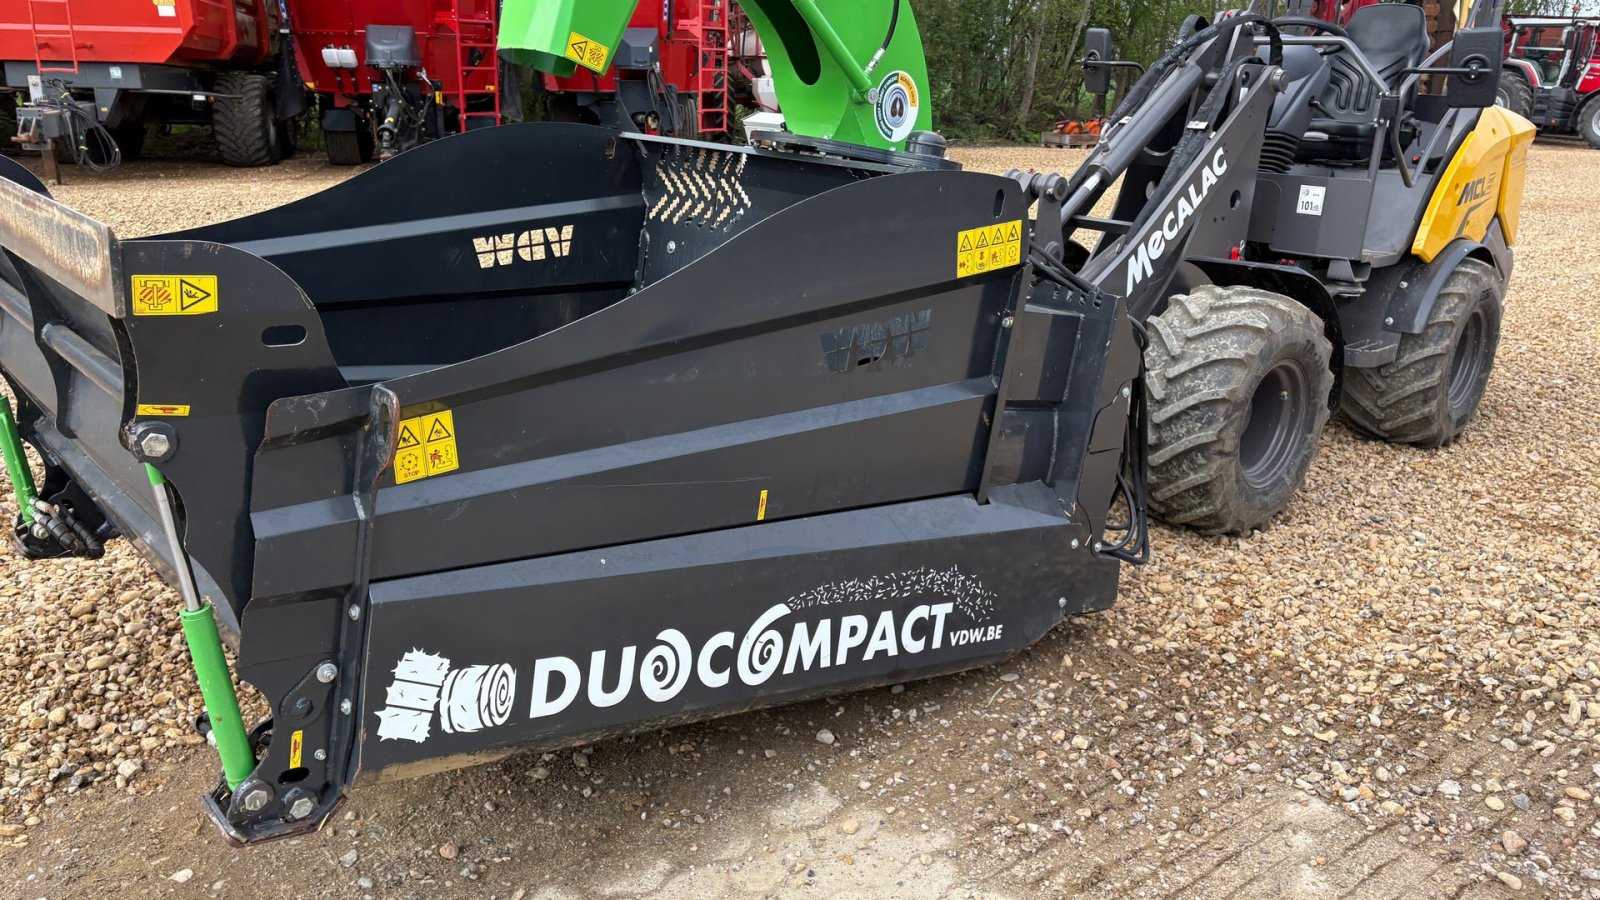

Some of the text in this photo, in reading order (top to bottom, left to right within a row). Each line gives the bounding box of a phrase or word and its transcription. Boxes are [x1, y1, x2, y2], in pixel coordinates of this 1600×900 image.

[1457, 177, 1486, 206] MCL
[403, 470, 420, 478] STOP
[529, 602, 1003, 719] DUOCOMPACT VDW.BE
